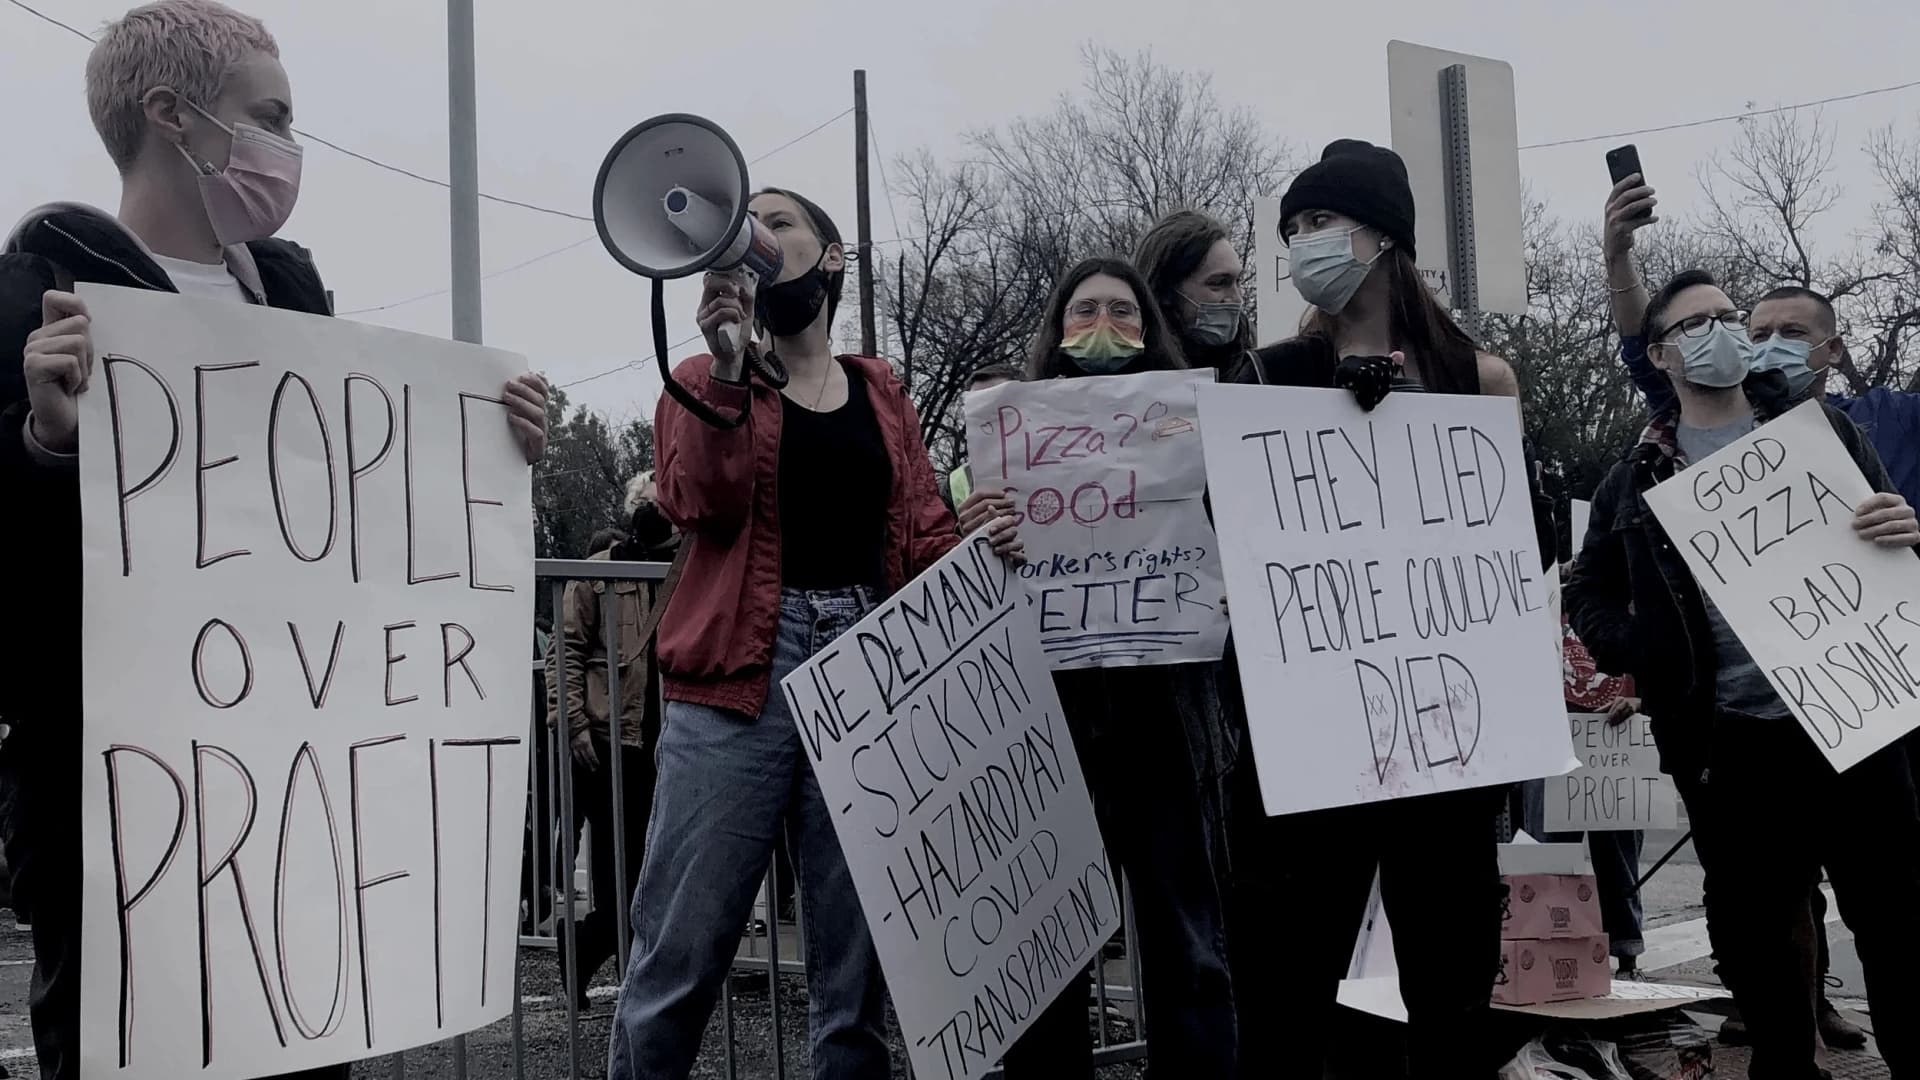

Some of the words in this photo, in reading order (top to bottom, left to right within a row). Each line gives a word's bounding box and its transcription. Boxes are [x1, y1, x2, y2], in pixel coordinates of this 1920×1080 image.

[102, 352, 514, 591] PEOPLE
[1241, 420, 1386, 533] THEY
[1406, 423, 1506, 528] LIED
[1693, 438, 1787, 512] GOOD
[1124, 546, 1206, 576] rights?
[1689, 471, 1856, 585] PIZZA
[787, 650, 870, 762] WE
[857, 536, 1007, 713] DEMAND
[1025, 571, 1214, 633] ETTER
[1265, 558, 1397, 663] PEOPLE
[1406, 550, 1543, 640] COULD'VE
[1769, 562, 1863, 640] BAD
[192, 618, 486, 709] OVER
[959, 627, 1031, 735] PAY
[1007, 712, 1065, 822] PAY
[1355, 653, 1481, 785] DIED
[1571, 719, 1656, 748] PEOPLE
[1589, 753, 1631, 768] OVER
[1567, 775, 1659, 822] PROFIT
[102, 733, 521, 1068] PROFIT
[944, 830, 1058, 977] COVID
